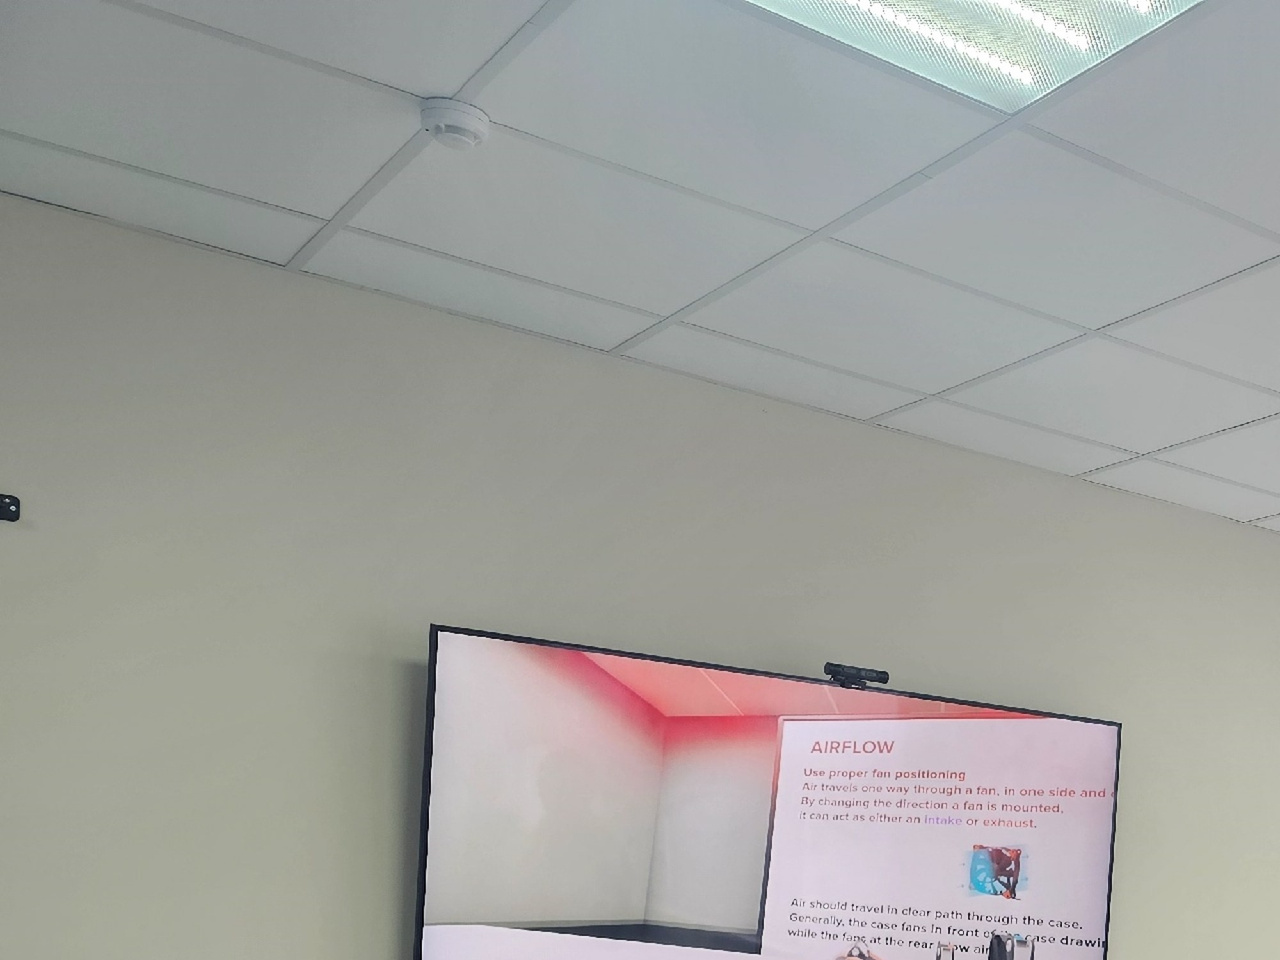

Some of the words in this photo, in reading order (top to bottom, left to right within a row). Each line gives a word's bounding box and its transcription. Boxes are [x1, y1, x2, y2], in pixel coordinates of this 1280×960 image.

[810, 740, 896, 754] AIRFLOW
[803, 768, 826, 777] Use
[828, 769, 869, 780] proper
[872, 769, 891, 778] fan
[895, 769, 966, 781] positioning
[802, 782, 818, 791] Air
[821, 783, 858, 792] travels
[861, 784, 883, 793] one
[886, 785, 910, 796] way
[913, 784, 962, 797] through
[965, 786, 973, 796] a
[1004, 786, 1015, 797] in
[1019, 788, 1045, 797] one
[1049, 787, 1076, 798] side
[1079, 787, 1106, 798] and
[800, 796, 815, 807] By
[818, 797, 870, 809] changing
[873, 798, 893, 809] the
[895, 799, 948, 810] direction
[952, 802, 959, 811] a
[963, 801, 983, 811] fan
[987, 801, 997, 811] is
[799, 811, 807, 821] it
[809, 812, 829, 821] can
[832, 812, 850, 821] act
[852, 814, 866, 822] as
[869, 813, 902, 824] either
[905, 815, 921, 824] an
[924, 815, 963, 826] intake
[966, 817, 979, 827] or
[983, 817, 1037, 829] exhaust.
[790, 898, 806, 908] Air
[809, 900, 848, 911] should
[851, 903, 884, 914] travel
[887, 905, 898, 915] in
[901, 907, 932, 917] clear
[935, 910, 963, 921] path
[967, 912, 1018, 926] through
[1023, 915, 1044, 926] the
[1048, 918, 1083, 930] case.
[789, 912, 845, 928] Generally,
[848, 917, 868, 928] the
[870, 920, 898, 931] case
[901, 921, 927, 933] fans
[931, 924, 942, 935] in
[947, 925, 980, 938] front
[788, 928, 817, 939] while
[820, 930, 839, 941] the
[869, 936, 882, 945] at
[885, 936, 905, 948] the
[908, 940, 935, 950] rear
